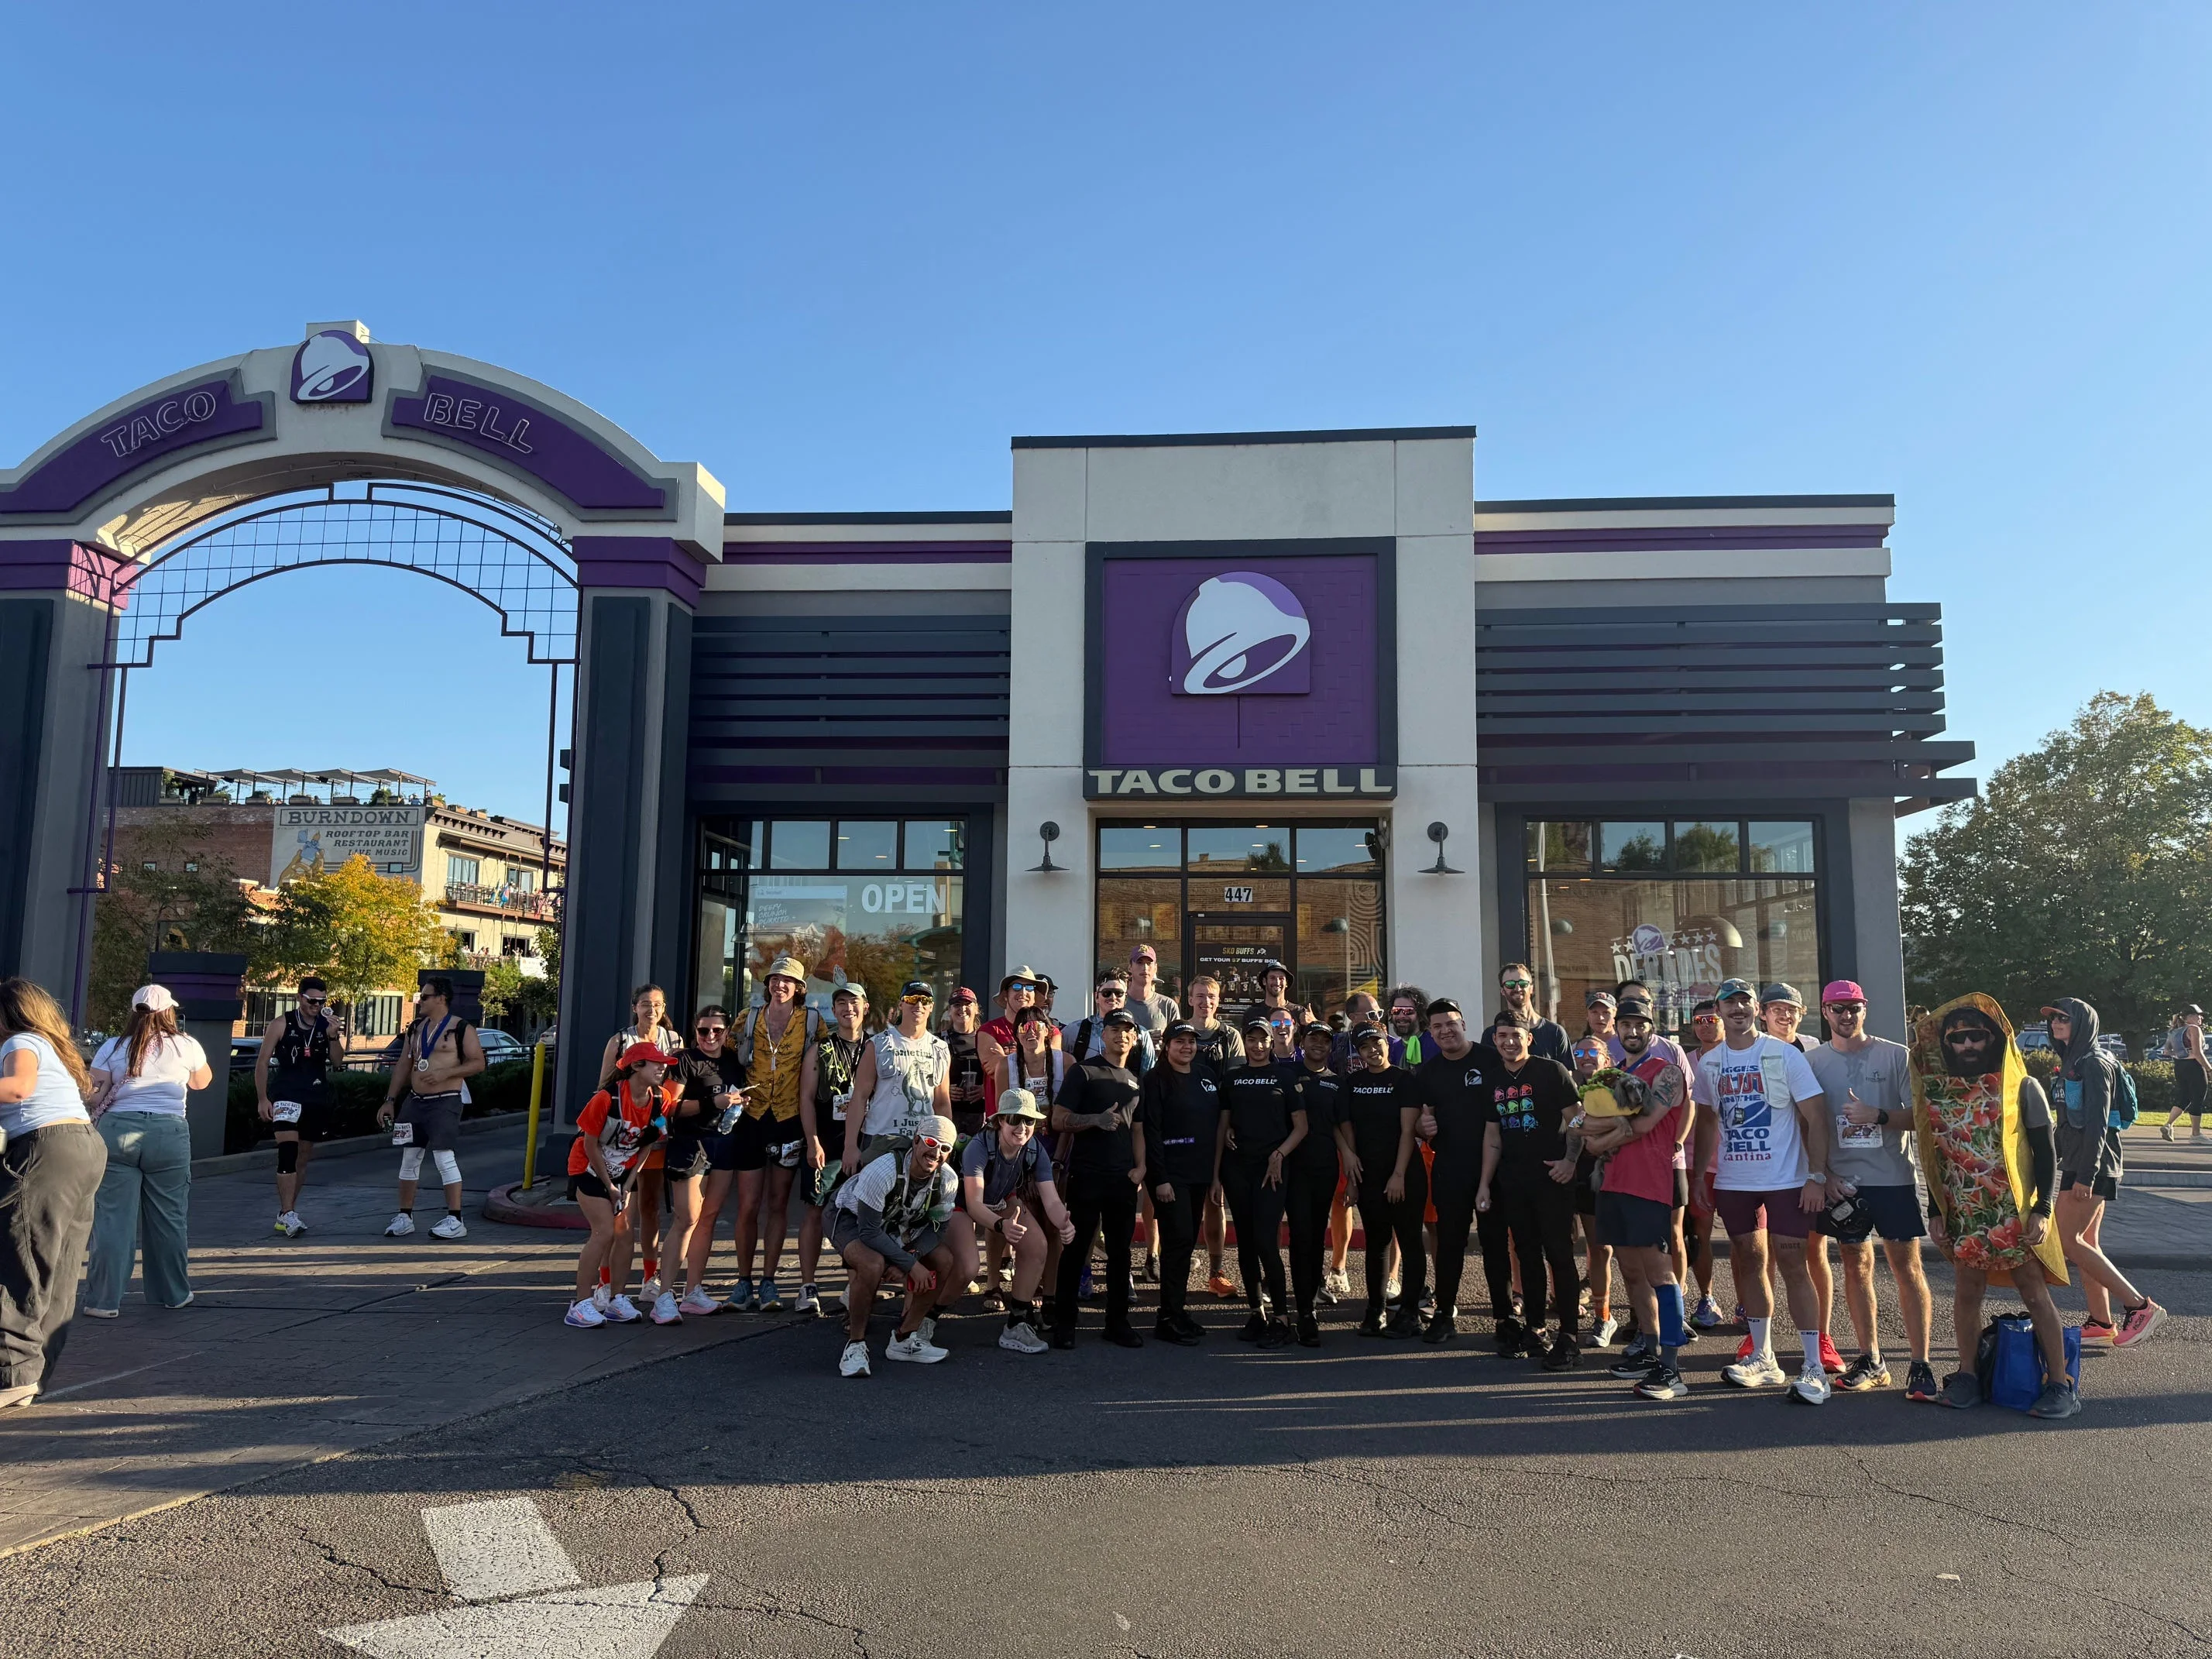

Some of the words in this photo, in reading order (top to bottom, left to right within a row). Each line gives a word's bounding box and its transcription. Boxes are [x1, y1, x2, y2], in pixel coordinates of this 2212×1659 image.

[100, 391, 216, 458] TACO
[423, 392, 533, 454] BELL
[1087, 769, 1236, 794] TACO
[1245, 768, 1393, 793] BELL
[287, 811, 410, 824] BURNDOWN
[861, 884, 946, 914] OPEN
[1225, 888, 1252, 902] 447
[1613, 943, 1723, 987] DECADES
[901, 1118, 919, 1127] Jus
